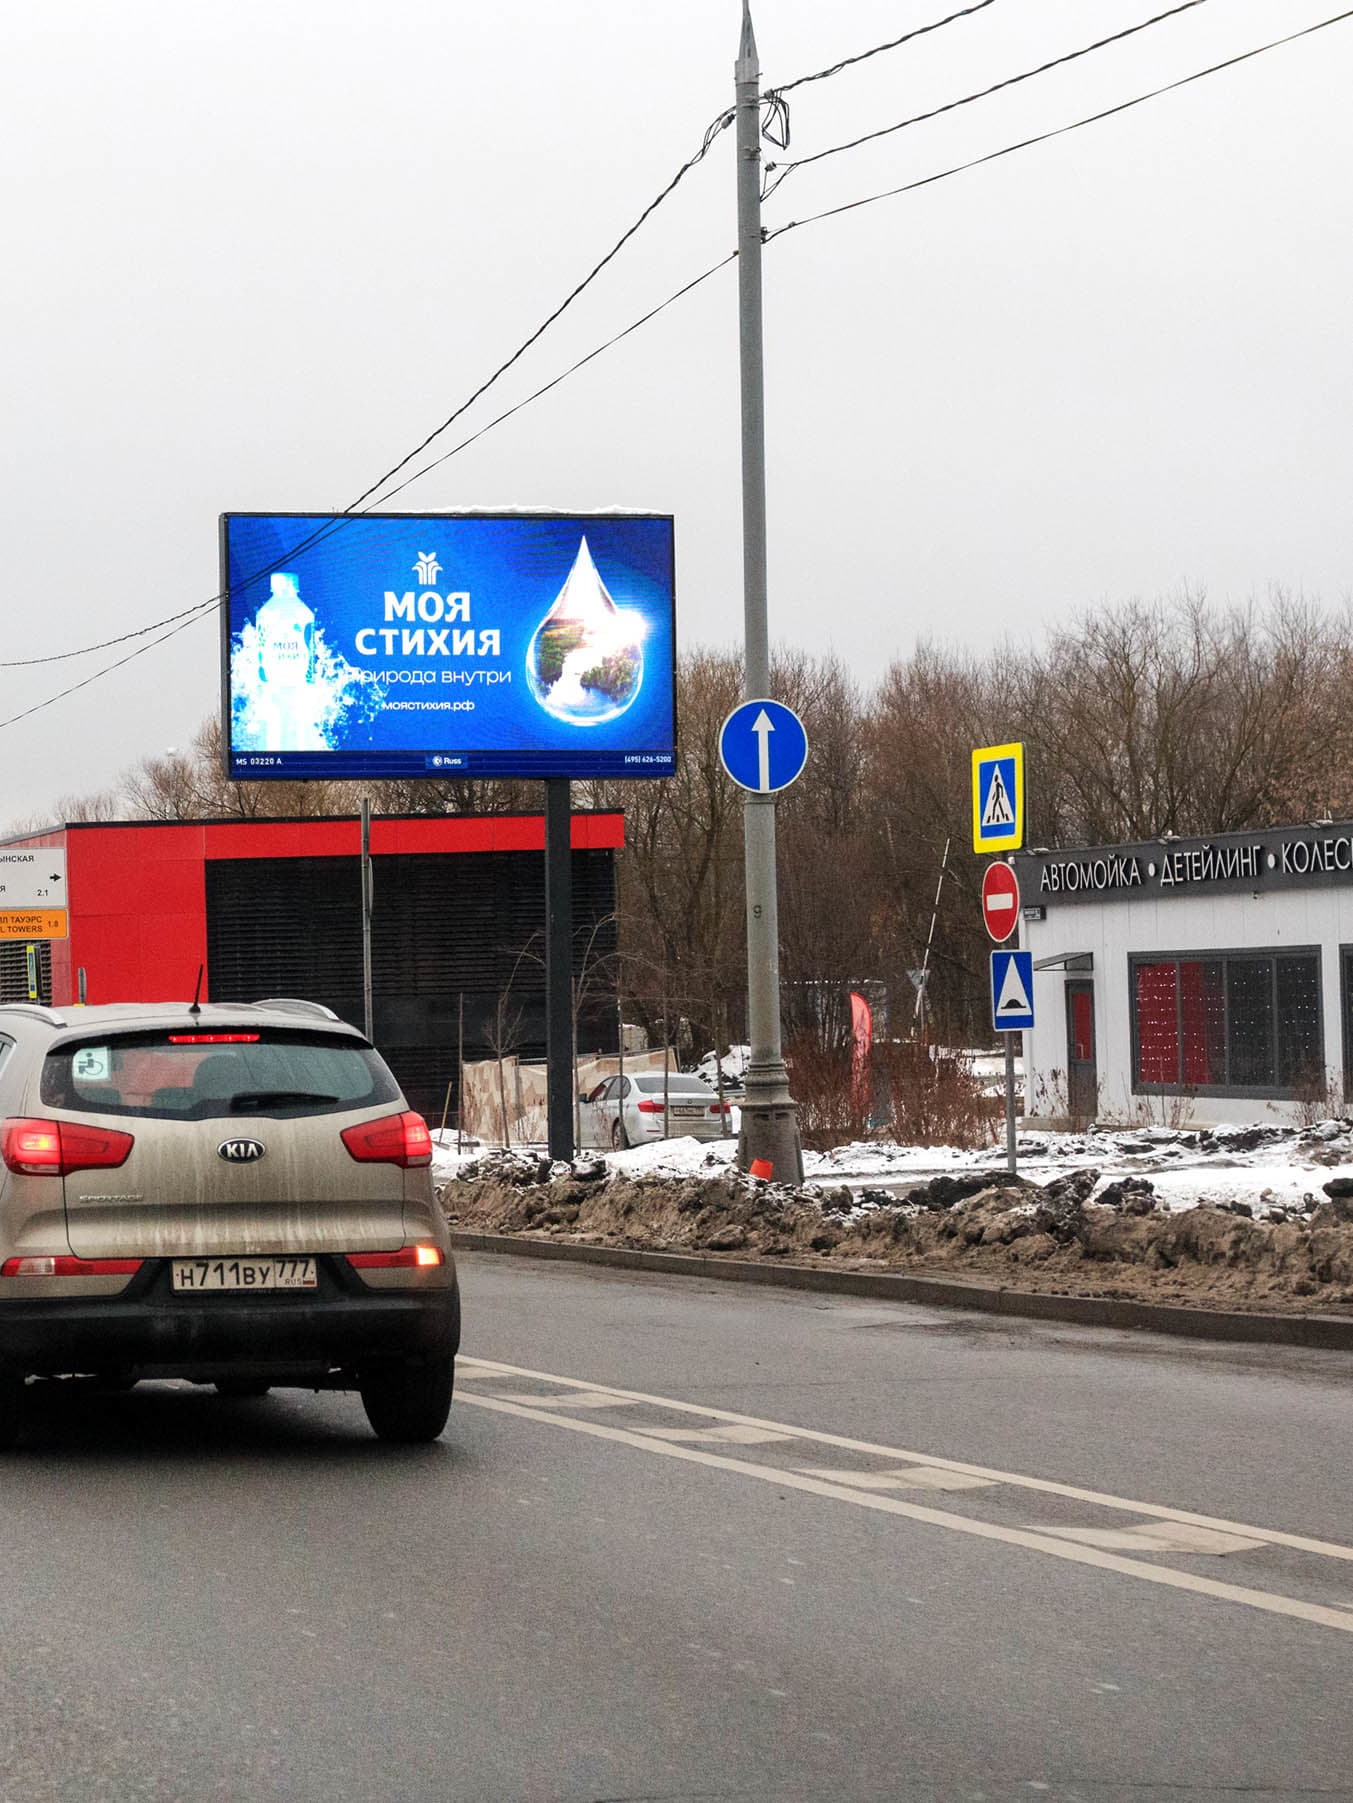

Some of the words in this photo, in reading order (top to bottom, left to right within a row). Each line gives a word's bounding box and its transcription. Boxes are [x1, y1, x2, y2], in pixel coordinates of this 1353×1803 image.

[383, 591, 470, 622] МОЯ
[355, 628, 501, 656] СТИХИЯ
[441, 669, 512, 687] внутри
[382, 700, 475, 712] моястихия.рф
[236, 757, 248, 766] MS
[443, 757, 462, 766] Russ
[1040, 853, 1142, 893] АВТОМОЙКА
[1160, 844, 1262, 887] ДЕТЕЙЛИНГ
[1281, 837, 1353, 874] КОЛЕС
[37, 889, 49, 897] 2.1
[11, 915, 43, 924] ТАУЭРС
[8, 925, 43, 933] TOWERS
[226, 1143, 259, 1158] KIA
[180, 1261, 270, 1287] Н711ВУ
[276, 1259, 310, 1278] 777
